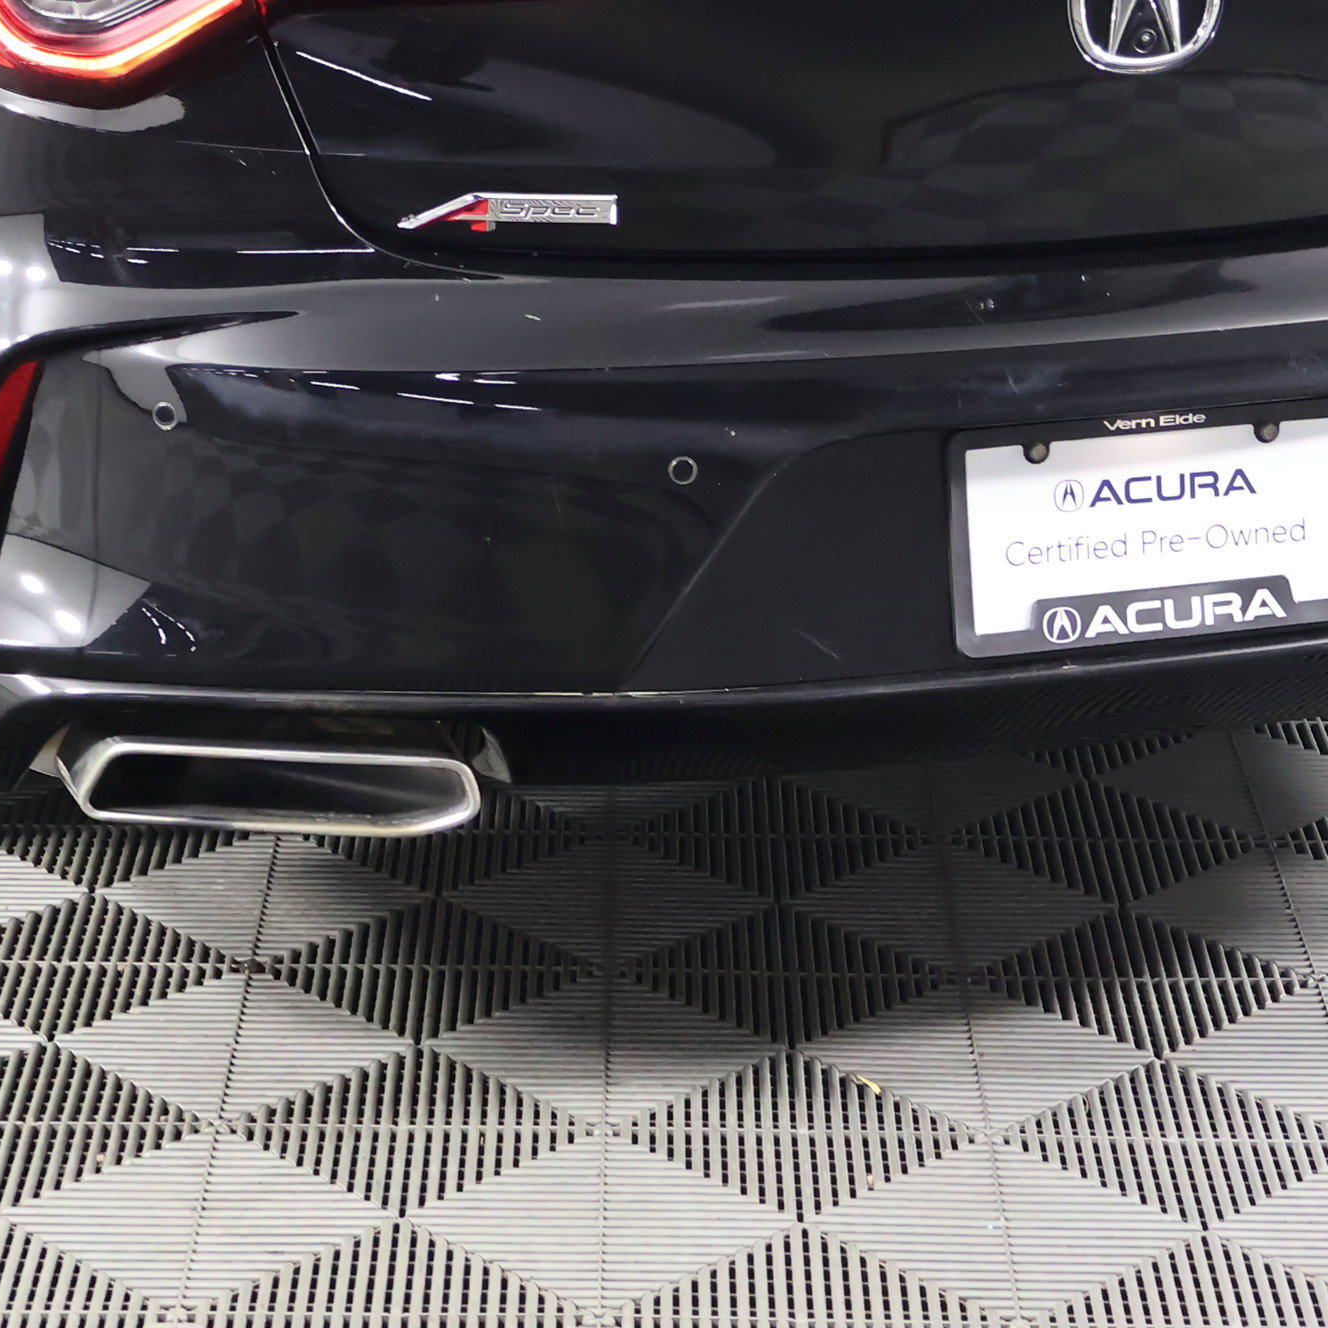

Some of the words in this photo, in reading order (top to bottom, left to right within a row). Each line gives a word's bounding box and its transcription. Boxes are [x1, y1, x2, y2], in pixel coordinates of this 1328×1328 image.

[1102, 416, 1156, 432] Vern
[1158, 411, 1207, 428] Eide
[1089, 468, 1258, 508] ACURA
[1004, 532, 1128, 567] Certified
[1141, 517, 1308, 556] Pre-Owned
[1084, 587, 1288, 639] ACURA
